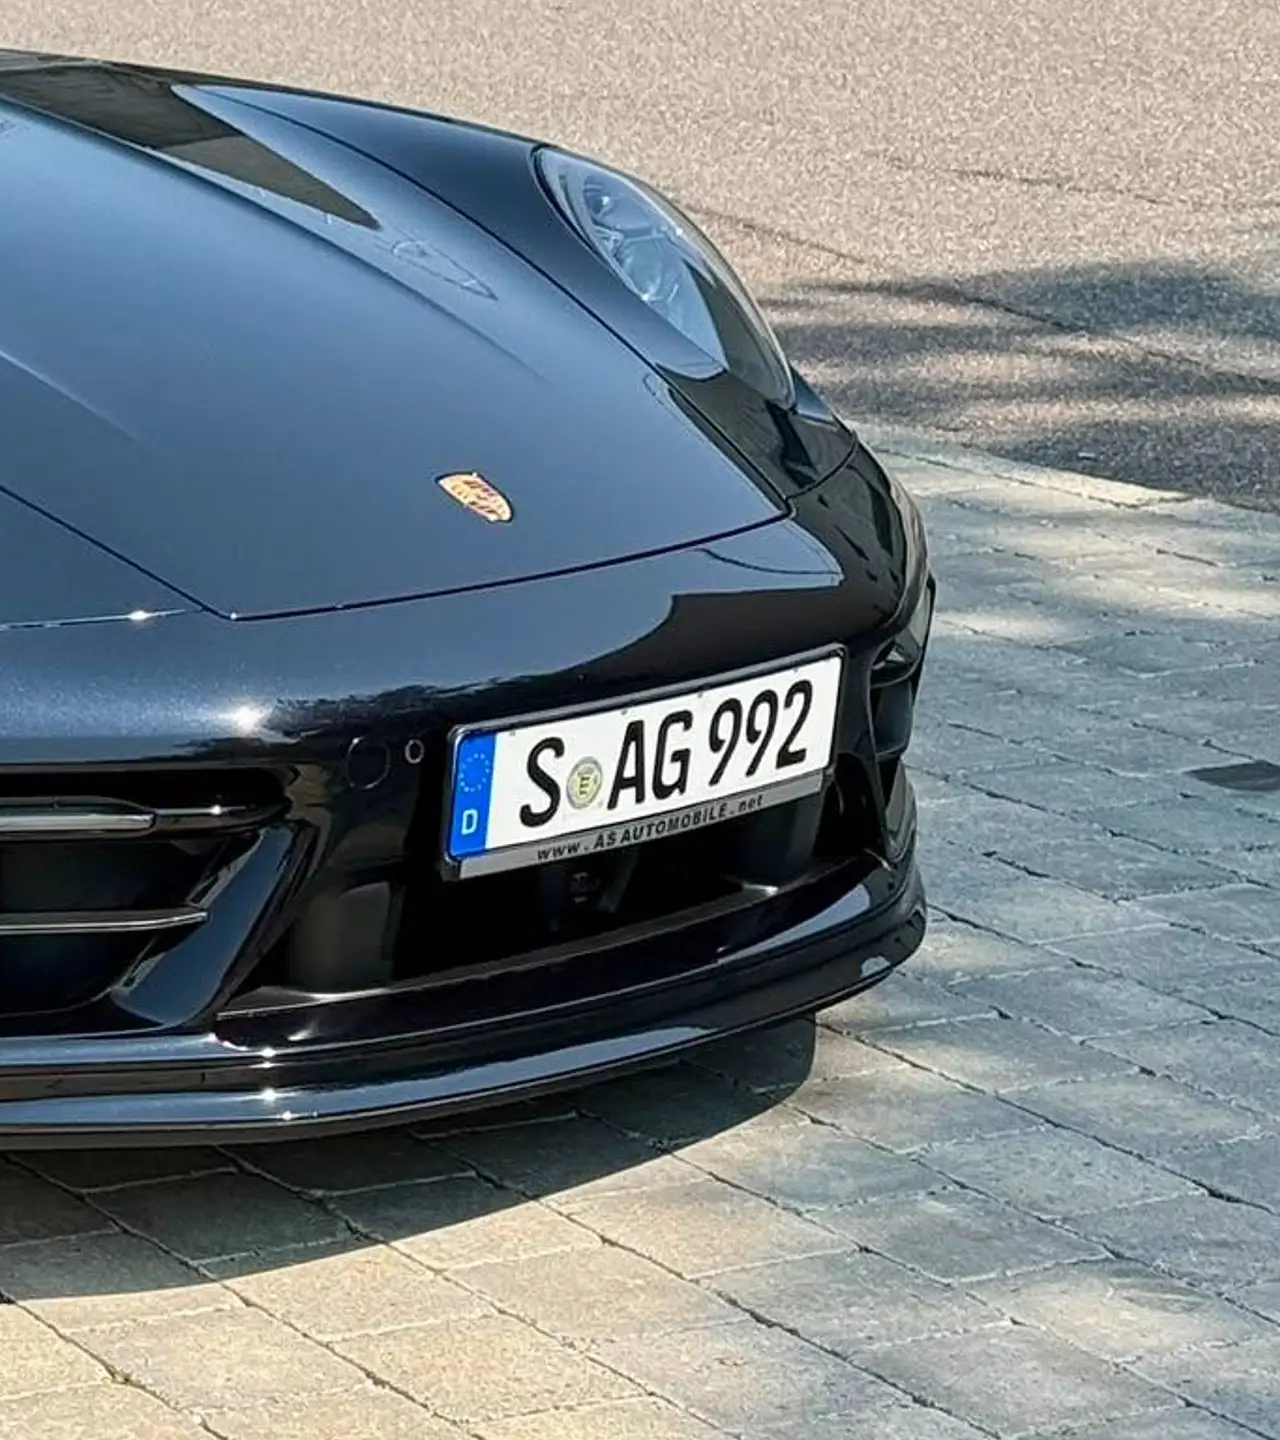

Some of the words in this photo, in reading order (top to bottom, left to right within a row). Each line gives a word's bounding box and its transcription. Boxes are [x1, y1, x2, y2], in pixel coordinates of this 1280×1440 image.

[519, 736, 565, 828] S
[606, 709, 694, 811] AG
[707, 678, 814, 786] 992
[460, 808, 478, 836] D
